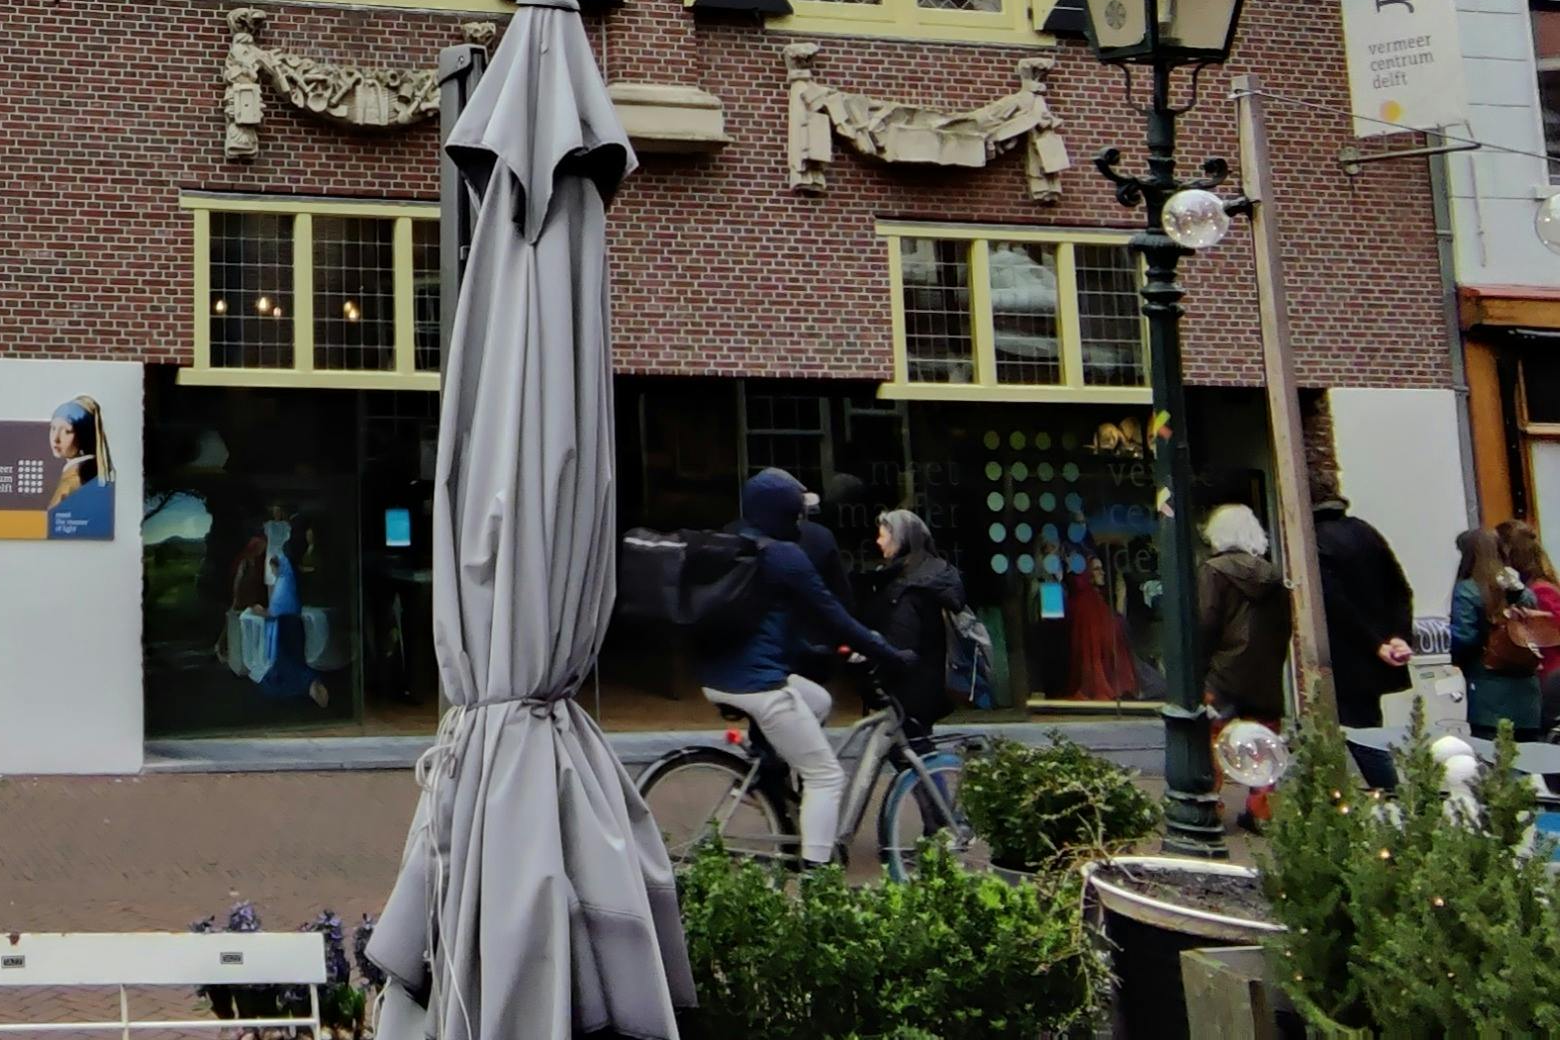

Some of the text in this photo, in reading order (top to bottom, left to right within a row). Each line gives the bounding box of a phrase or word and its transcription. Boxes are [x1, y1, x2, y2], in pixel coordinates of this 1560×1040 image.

[1368, 35, 1432, 56] vermeer
[1370, 51, 1435, 72] centrum
[1372, 71, 1408, 89] delft
